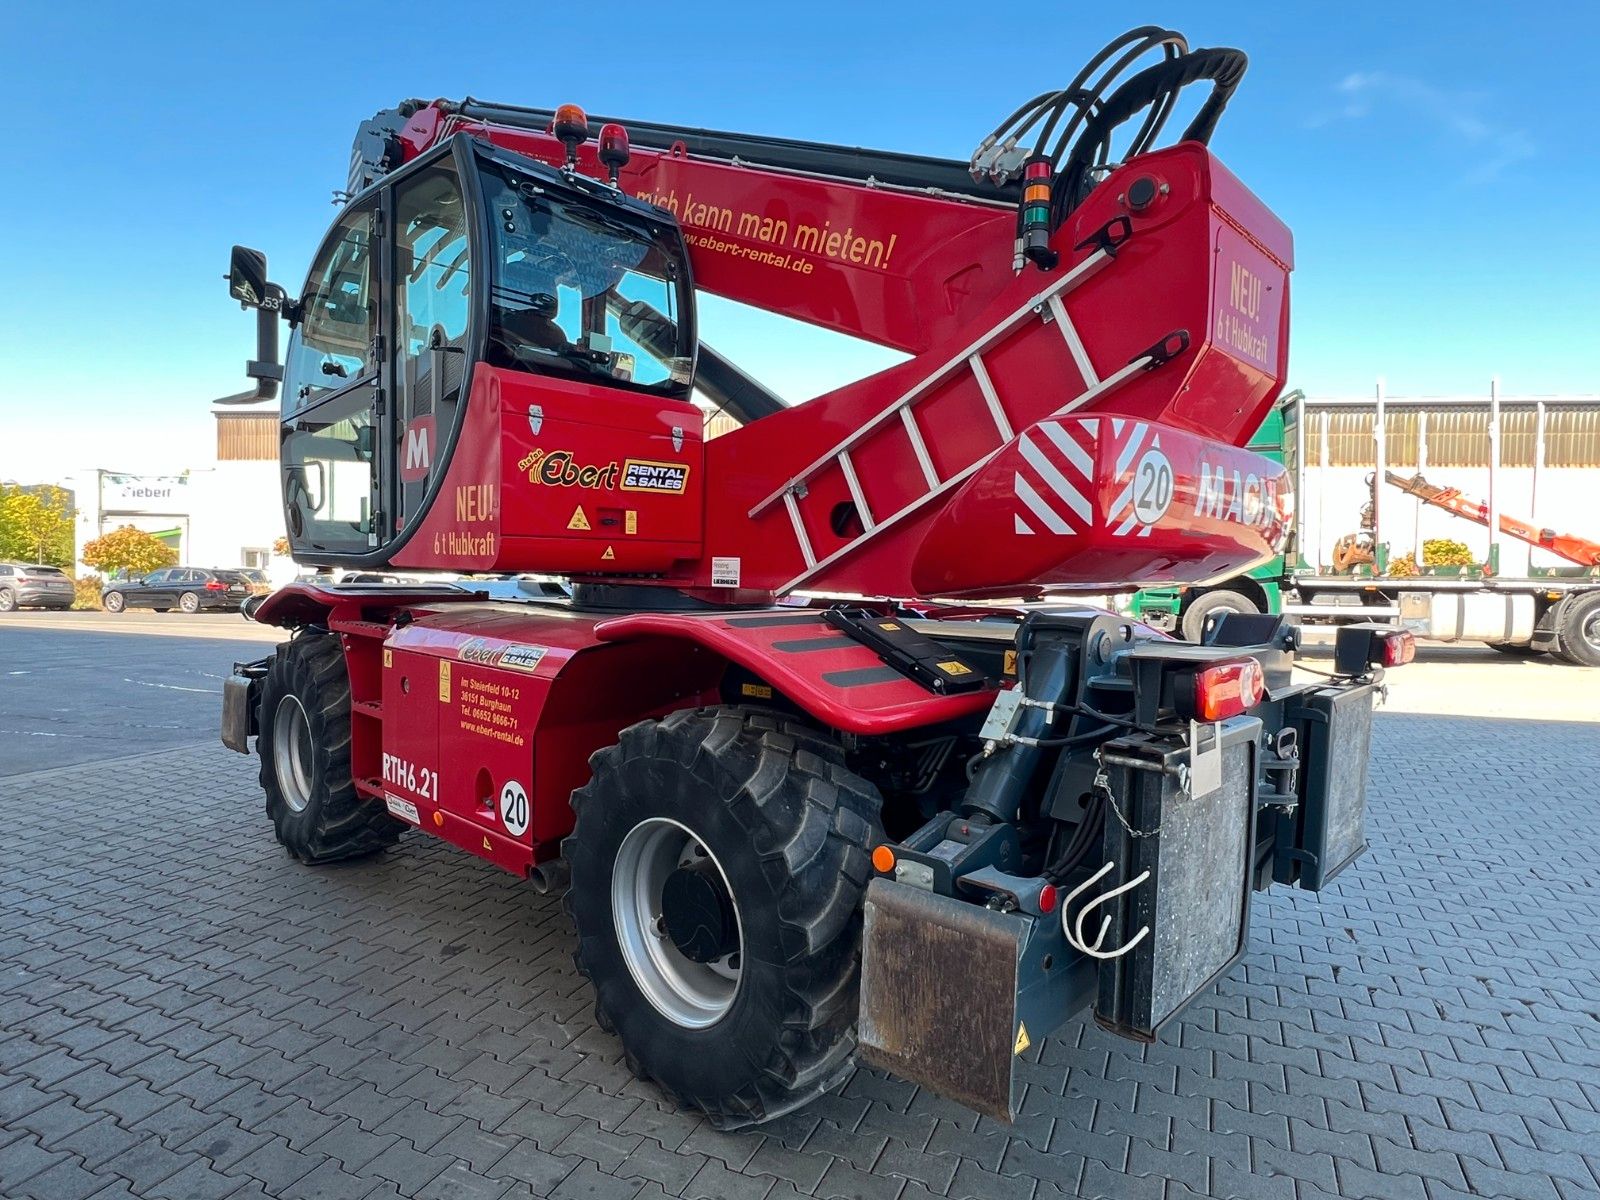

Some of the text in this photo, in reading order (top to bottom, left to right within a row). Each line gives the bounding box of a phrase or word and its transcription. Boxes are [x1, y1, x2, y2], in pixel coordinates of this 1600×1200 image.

[682, 193, 732, 232] kann
[736, 211, 789, 245] man
[793, 220, 897, 269] mieten!
[1230, 260, 1261, 323] NEU!
[1217, 308, 1268, 364] 6 t Hubkraft
[406, 427, 429, 470] M
[518, 448, 544, 470] Stefan
[540, 450, 620, 490] Ebert
[628, 464, 684, 479] RENTAL
[1137, 461, 1170, 511] 20
[456, 484, 494, 522] NEU!
[434, 531, 495, 556] 6 t Hubkraft
[461, 691, 512, 713] 36151 Burghaun
[461, 704, 471, 716] Tel.
[501, 687, 519, 700] 10-12
[460, 720, 524, 747] www.ebert-rental.de
[382, 752, 438, 802] RTH6.21
[504, 788, 527, 829] 20
